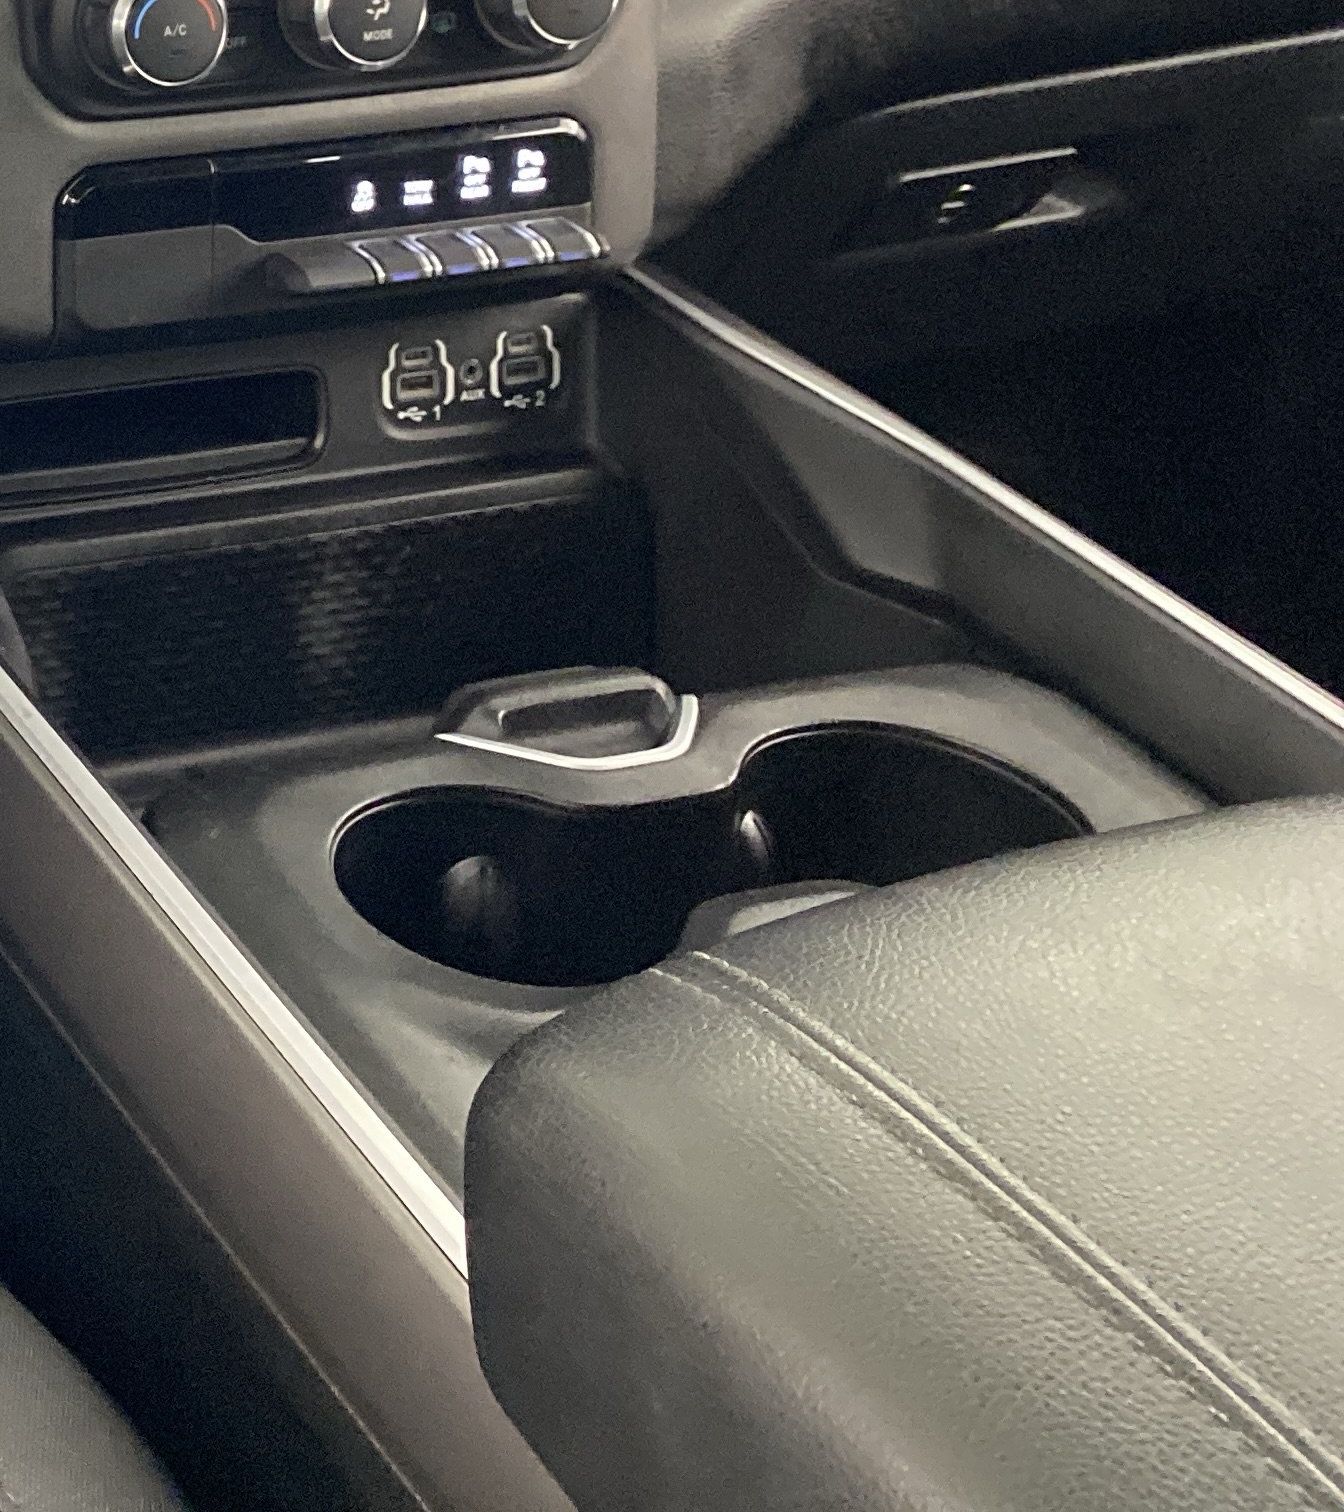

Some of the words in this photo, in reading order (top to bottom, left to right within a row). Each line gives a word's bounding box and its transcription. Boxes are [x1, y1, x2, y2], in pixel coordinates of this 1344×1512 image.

[163, 23, 188, 38] A/C
[363, 28, 393, 42] MODE
[534, 389, 546, 407] 2
[432, 404, 442, 422] 1
